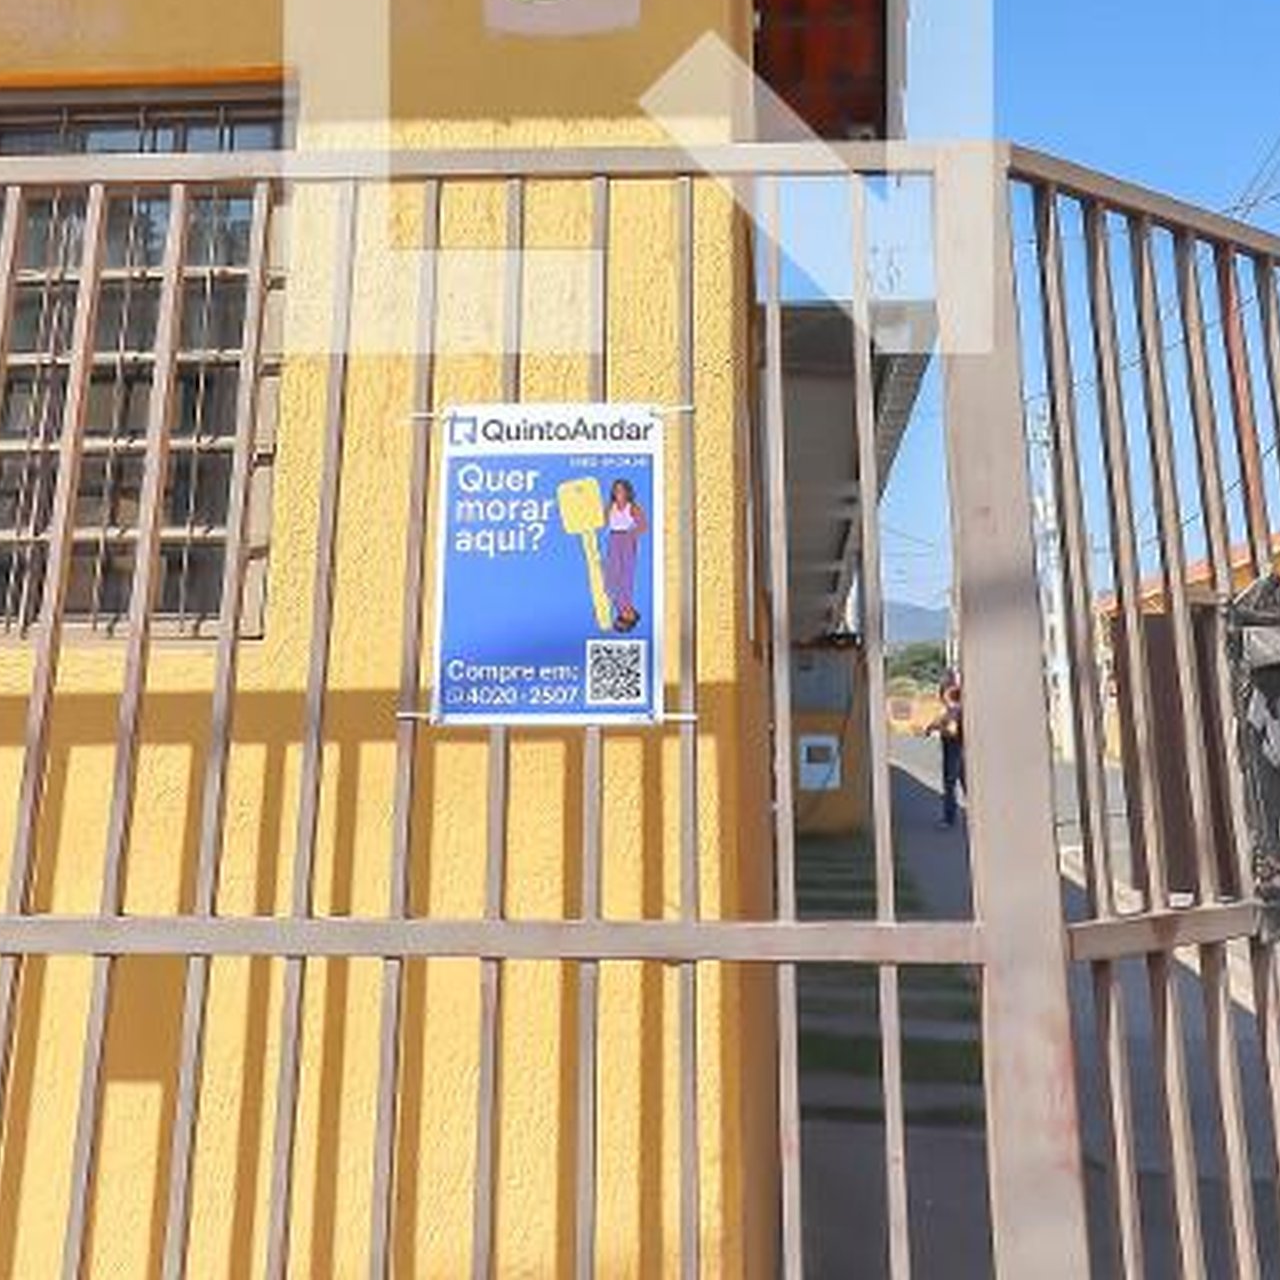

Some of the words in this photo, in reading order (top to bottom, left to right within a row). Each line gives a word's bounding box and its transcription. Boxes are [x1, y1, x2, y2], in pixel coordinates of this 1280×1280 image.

[481, 417, 654, 442] QuintoAndar
[457, 462, 539, 492] Quer
[455, 497, 552, 522] morar
[455, 523, 545, 557] aqui?
[447, 659, 534, 683] Compre
